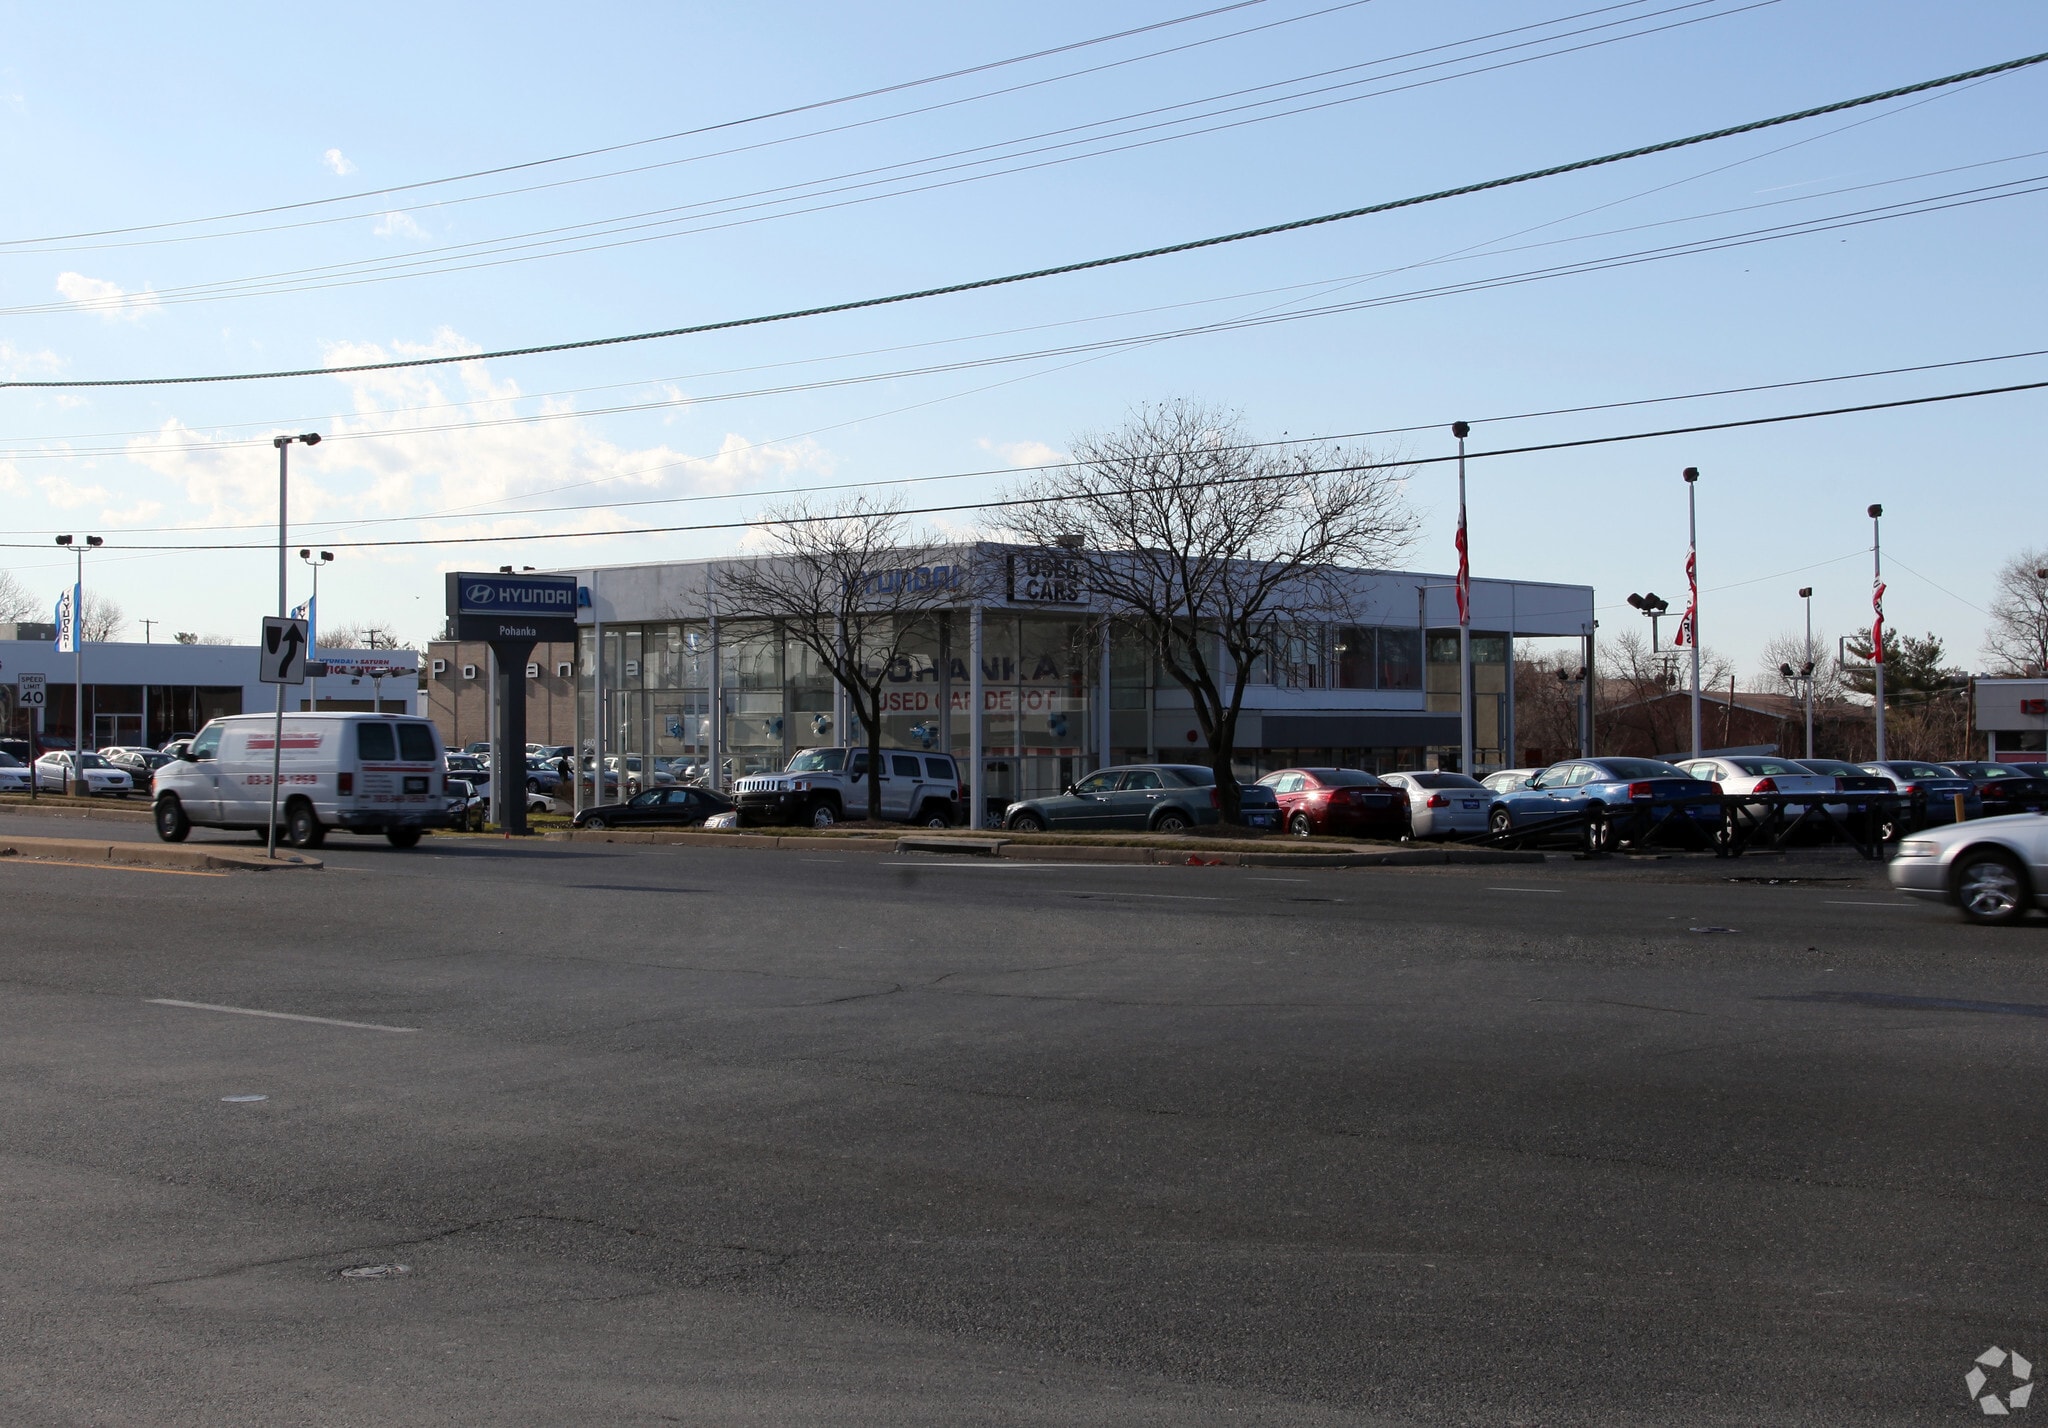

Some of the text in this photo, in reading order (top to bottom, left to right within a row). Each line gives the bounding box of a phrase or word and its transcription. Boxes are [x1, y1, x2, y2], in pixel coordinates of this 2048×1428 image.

[499, 587, 572, 605] HYUNDAI
[1026, 579, 1079, 601] CARS
[499, 625, 537, 637] Pohanka
[432, 658, 639, 681] Poana
[21, 691, 44, 704] 40
[935, 691, 971, 710] AR
[984, 690, 1056, 711] DEOT
